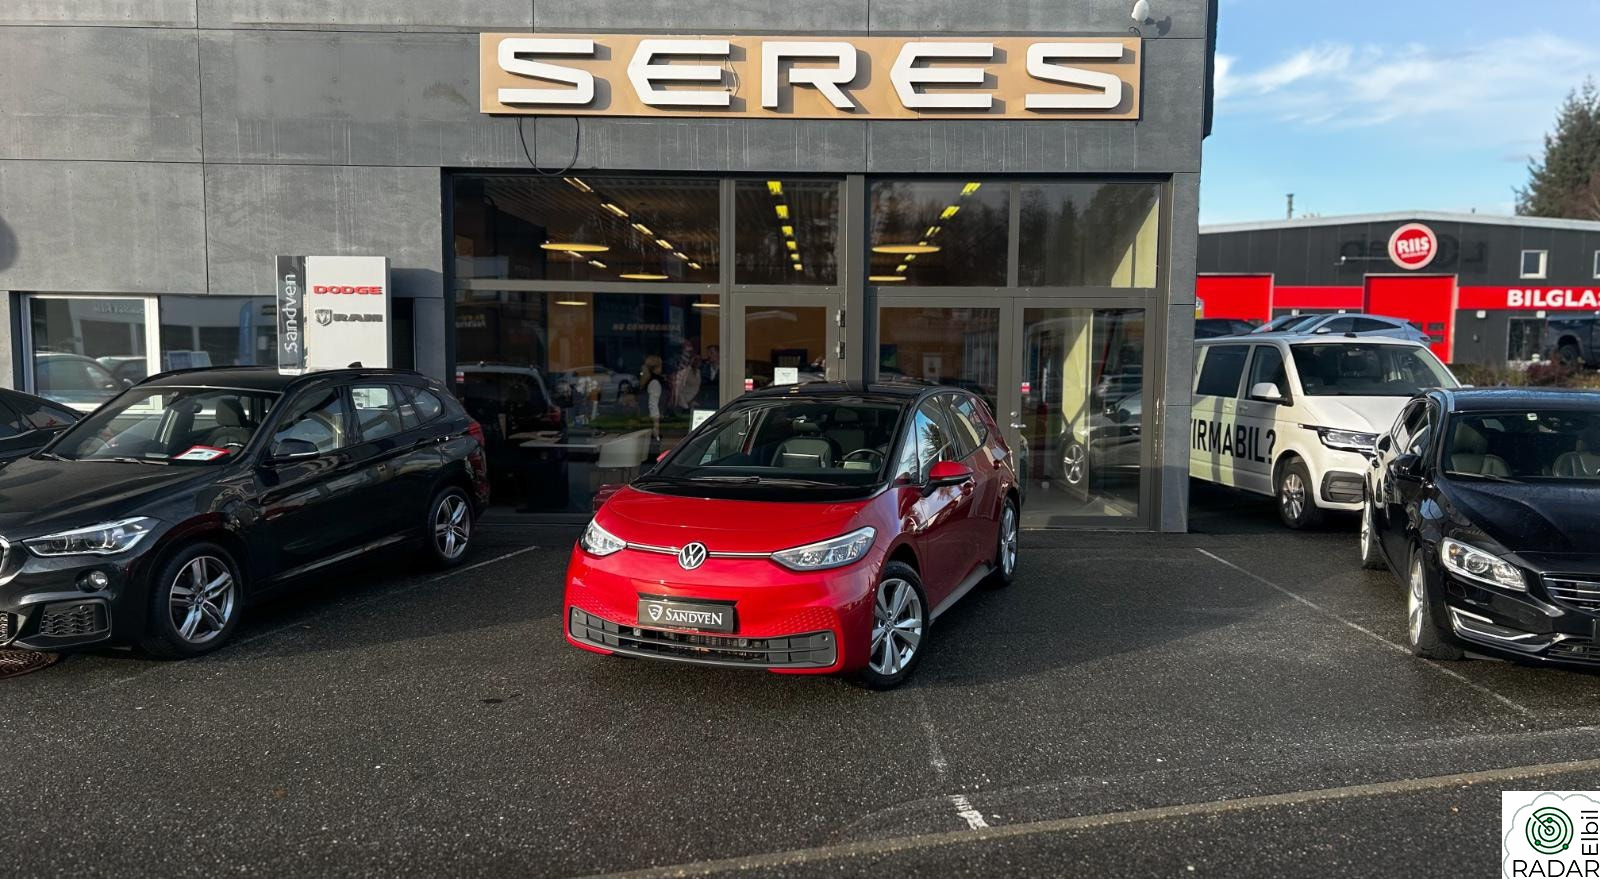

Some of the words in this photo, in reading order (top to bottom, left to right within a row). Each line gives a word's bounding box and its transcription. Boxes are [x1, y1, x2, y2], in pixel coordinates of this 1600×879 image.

[497, 38, 1124, 110] SERES
[1397, 236, 1430, 254] RIIS
[313, 285, 383, 295] DODGE
[1507, 289, 1600, 308] BILGLA
[282, 274, 298, 354] Sandven
[333, 313, 384, 322] RAM
[1191, 418, 1277, 465] IRMABIL?
